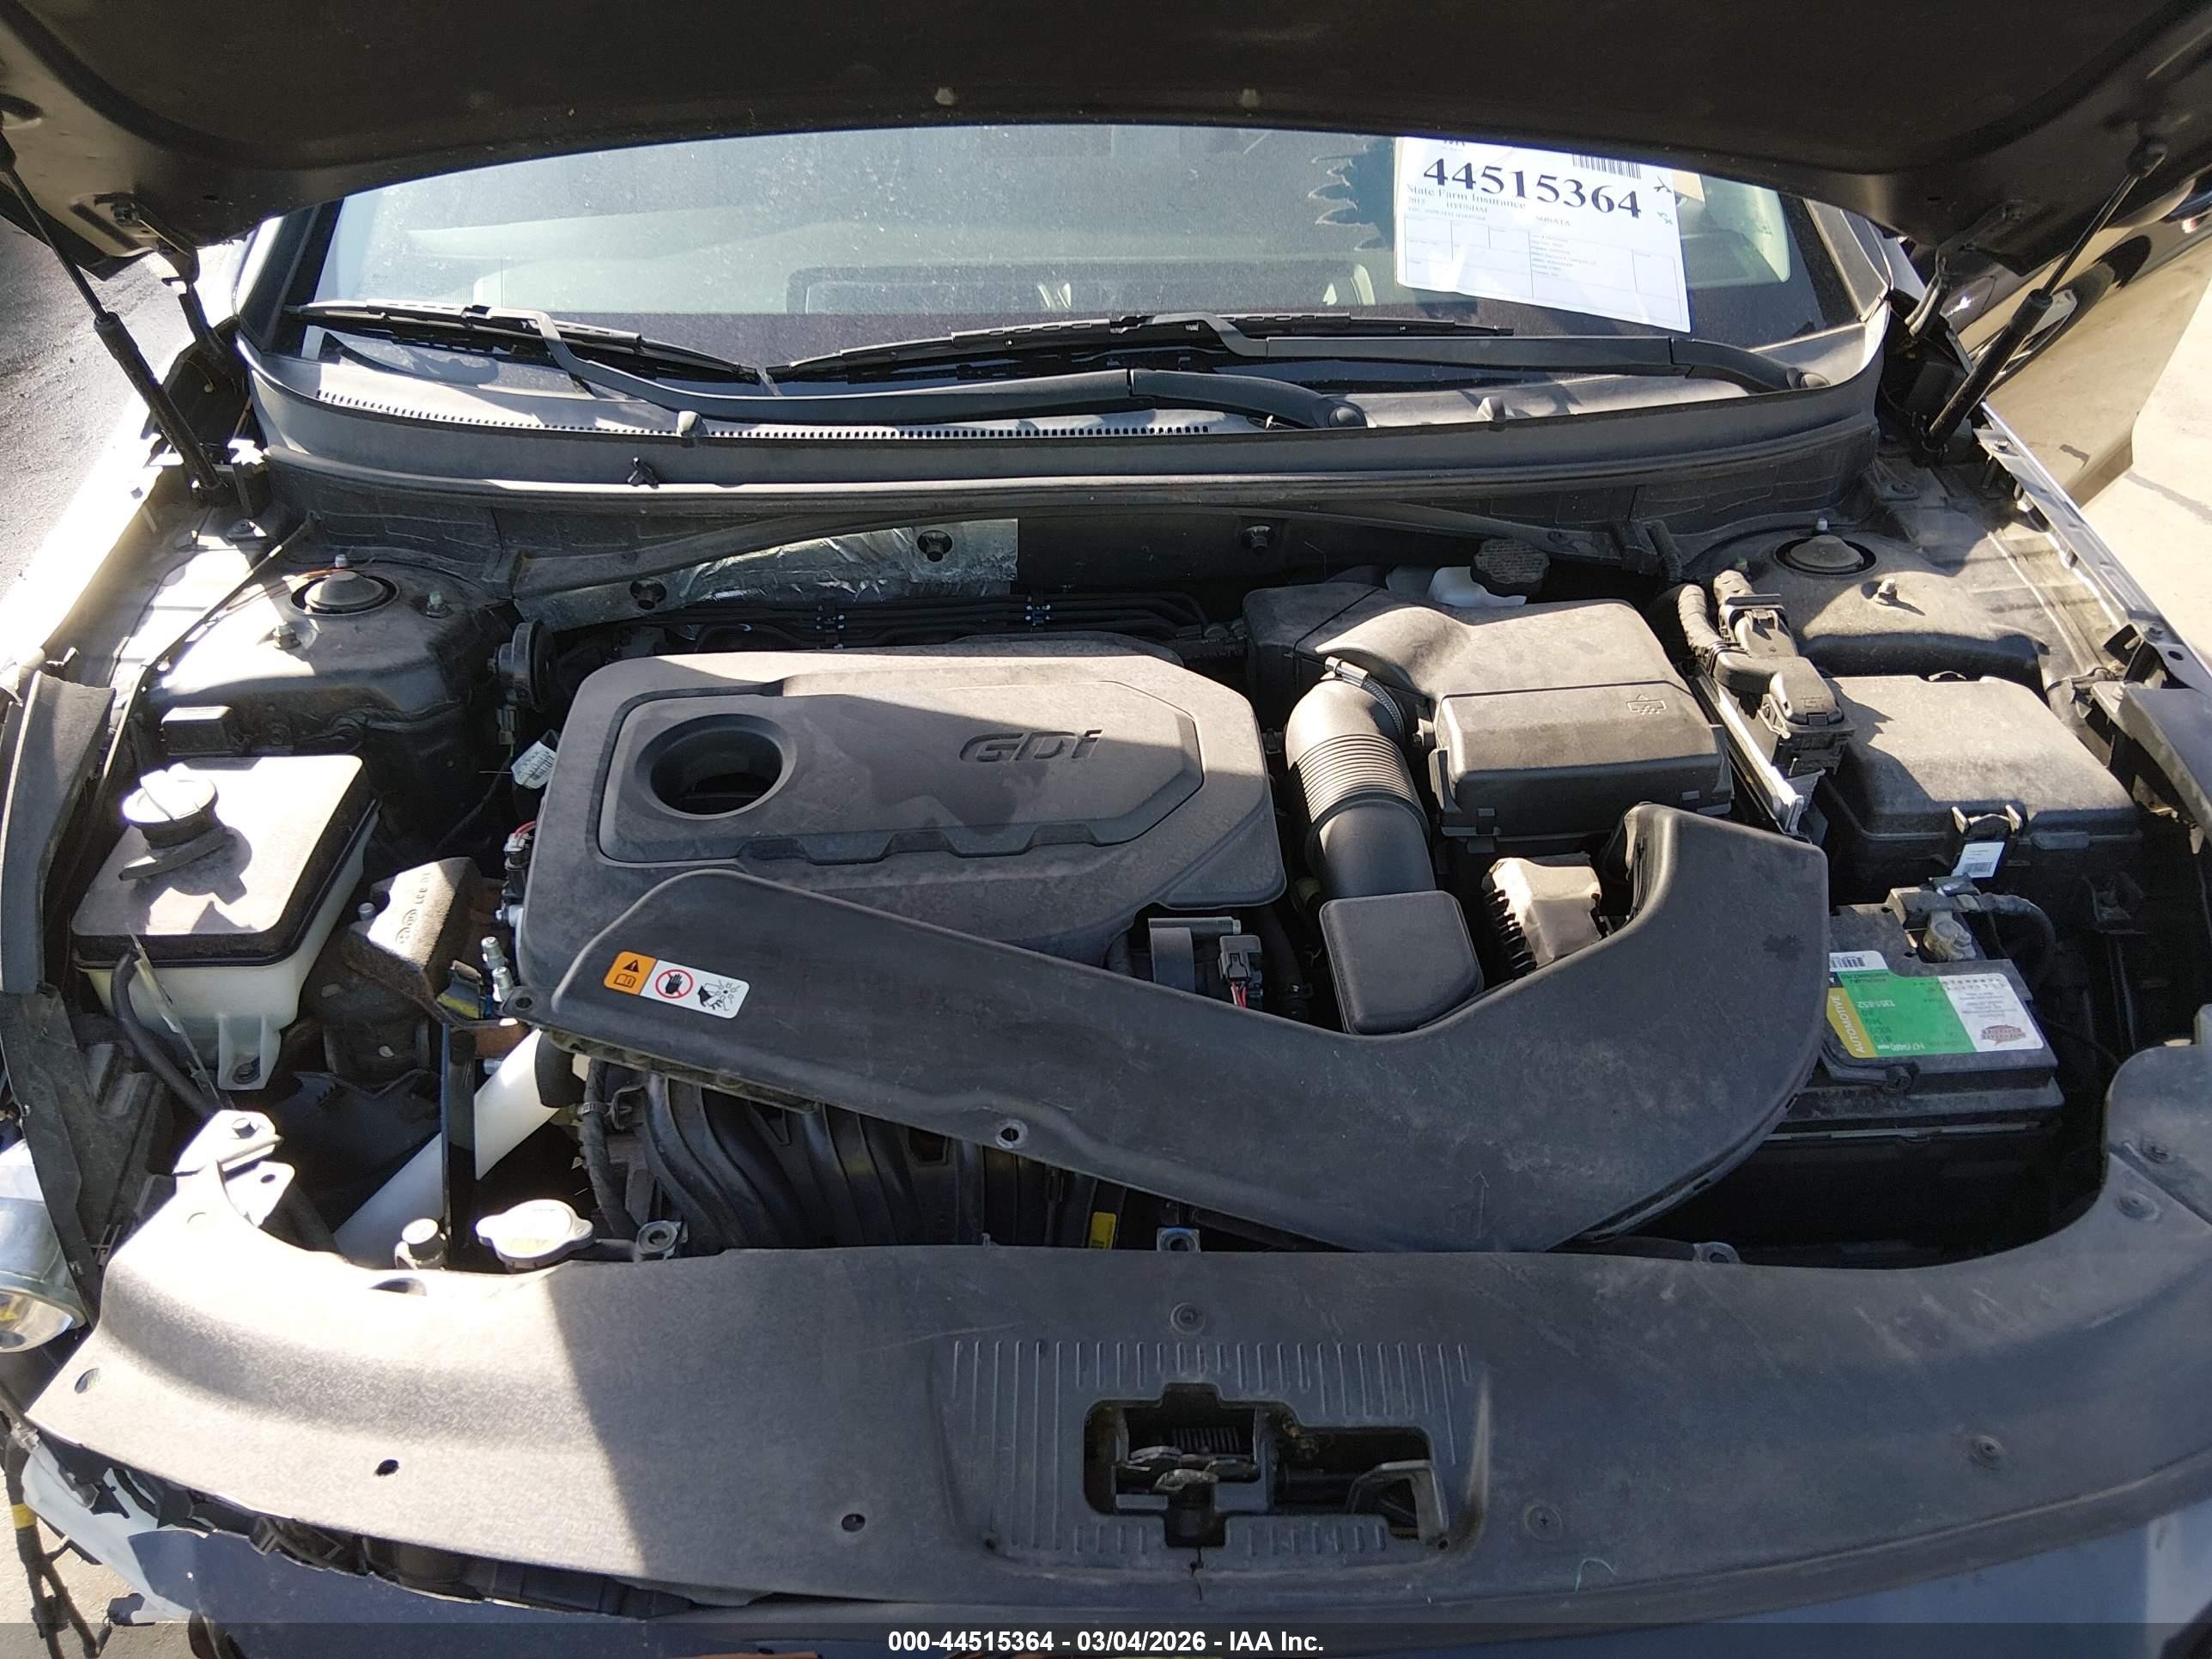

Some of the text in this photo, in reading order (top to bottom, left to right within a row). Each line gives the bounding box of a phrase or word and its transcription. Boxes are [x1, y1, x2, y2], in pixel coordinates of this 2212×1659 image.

[1407, 183, 1526, 210] State Farm Insurance
[1424, 158, 1641, 218] 44515364
[1447, 202, 1487, 213] HYUNDAI
[1830, 995, 1865, 1053] AUTOMOTIVE
